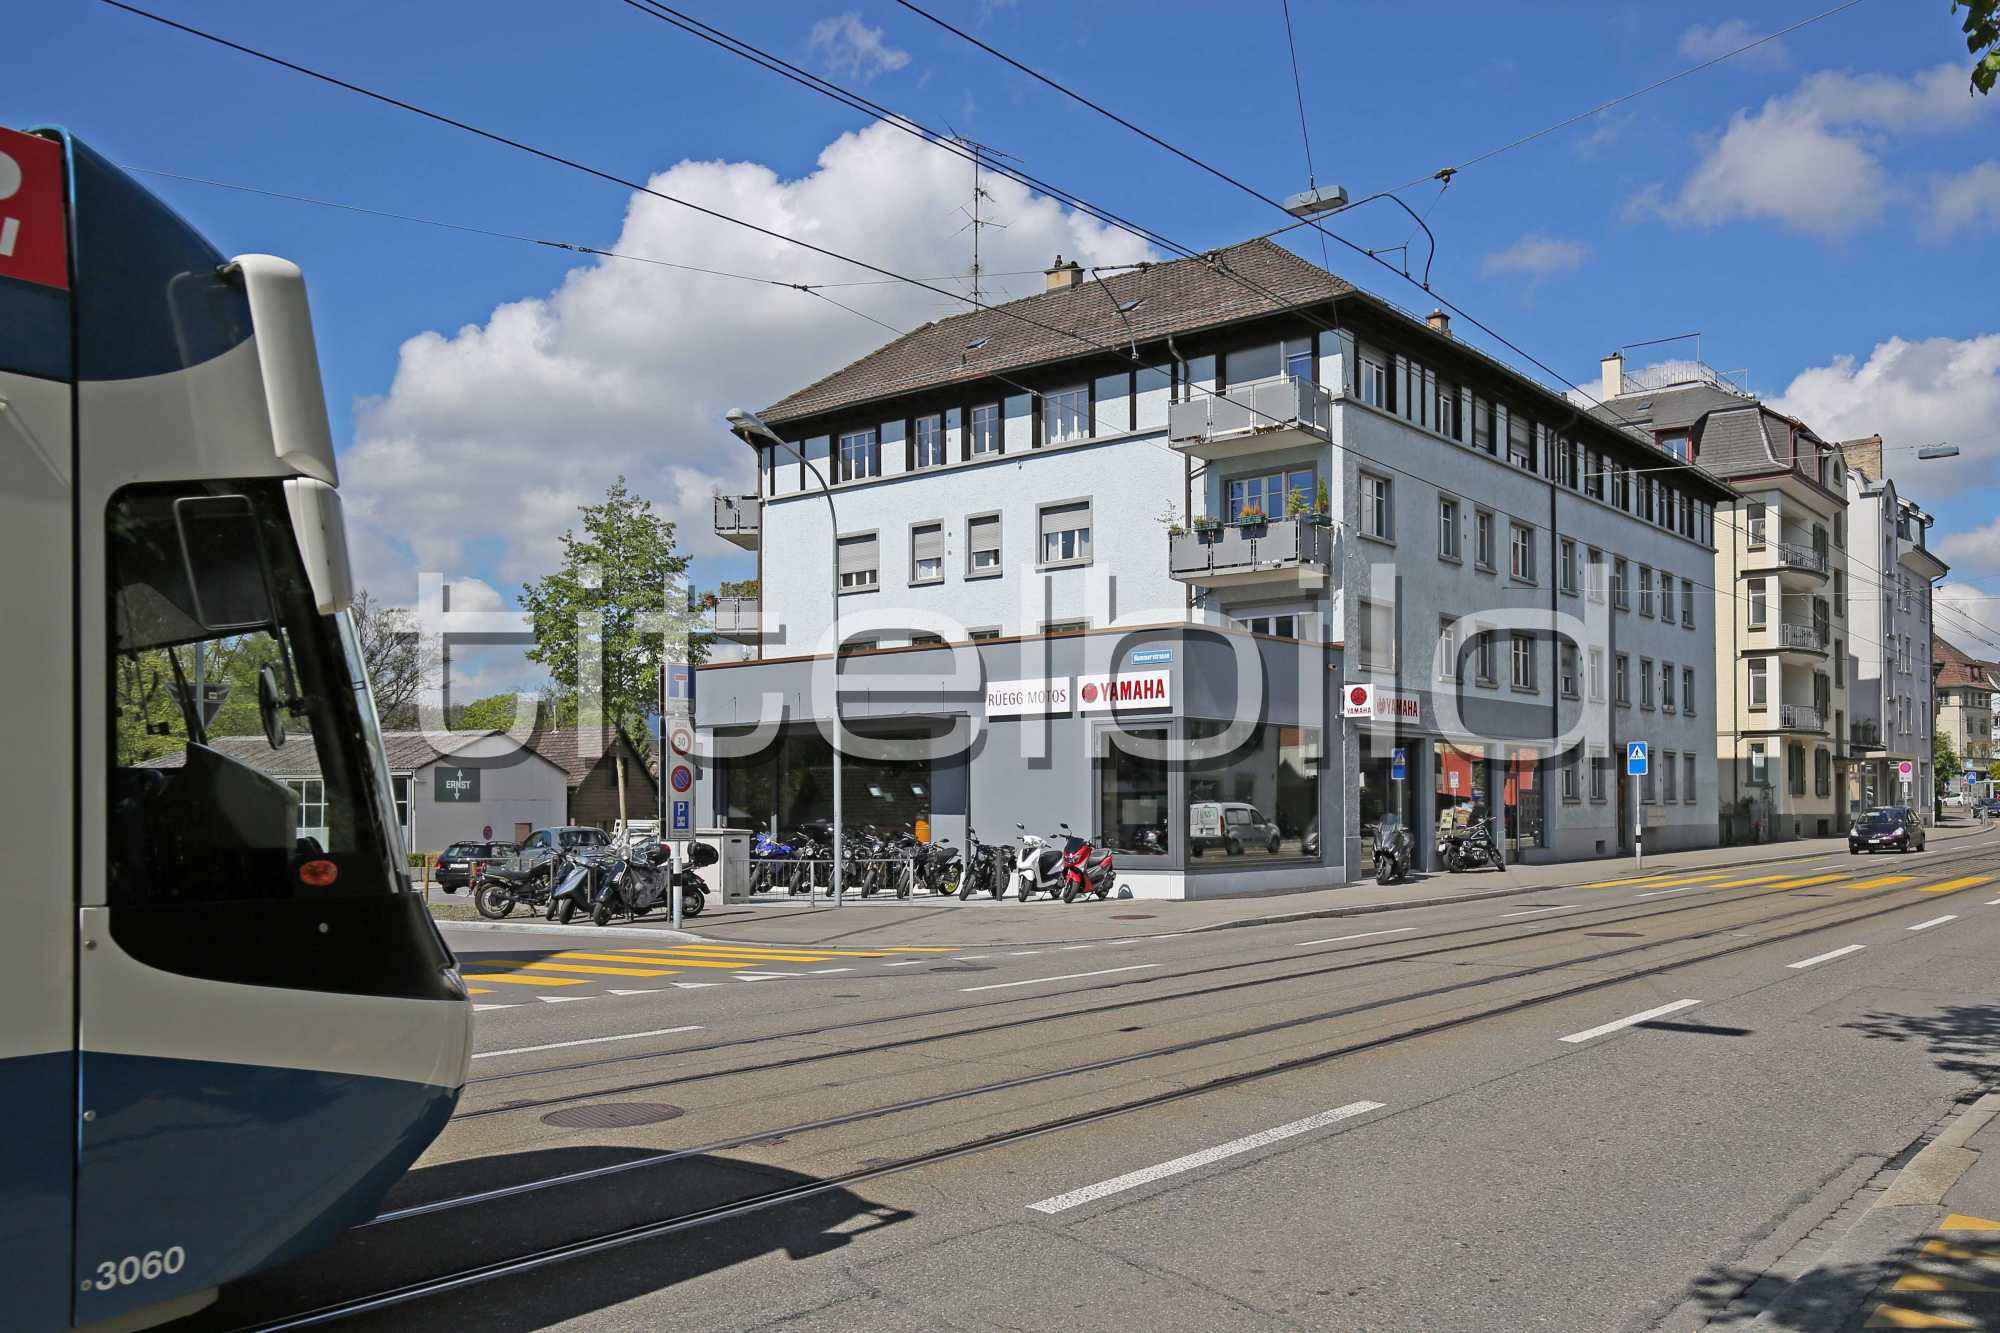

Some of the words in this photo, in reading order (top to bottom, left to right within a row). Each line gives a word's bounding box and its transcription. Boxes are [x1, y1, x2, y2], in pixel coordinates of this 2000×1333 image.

[988, 691, 1023, 706] RÜEGG
[1027, 689, 1066, 704] MOTOS
[1101, 678, 1165, 702] YAMAHA
[1346, 706, 1372, 715] YAMAHA
[1386, 697, 1418, 717] YAMAHA
[677, 736, 686, 747] 30
[446, 780, 471, 789] ERNST
[677, 802, 685, 816] P
[95, 1246, 186, 1291] 3060
